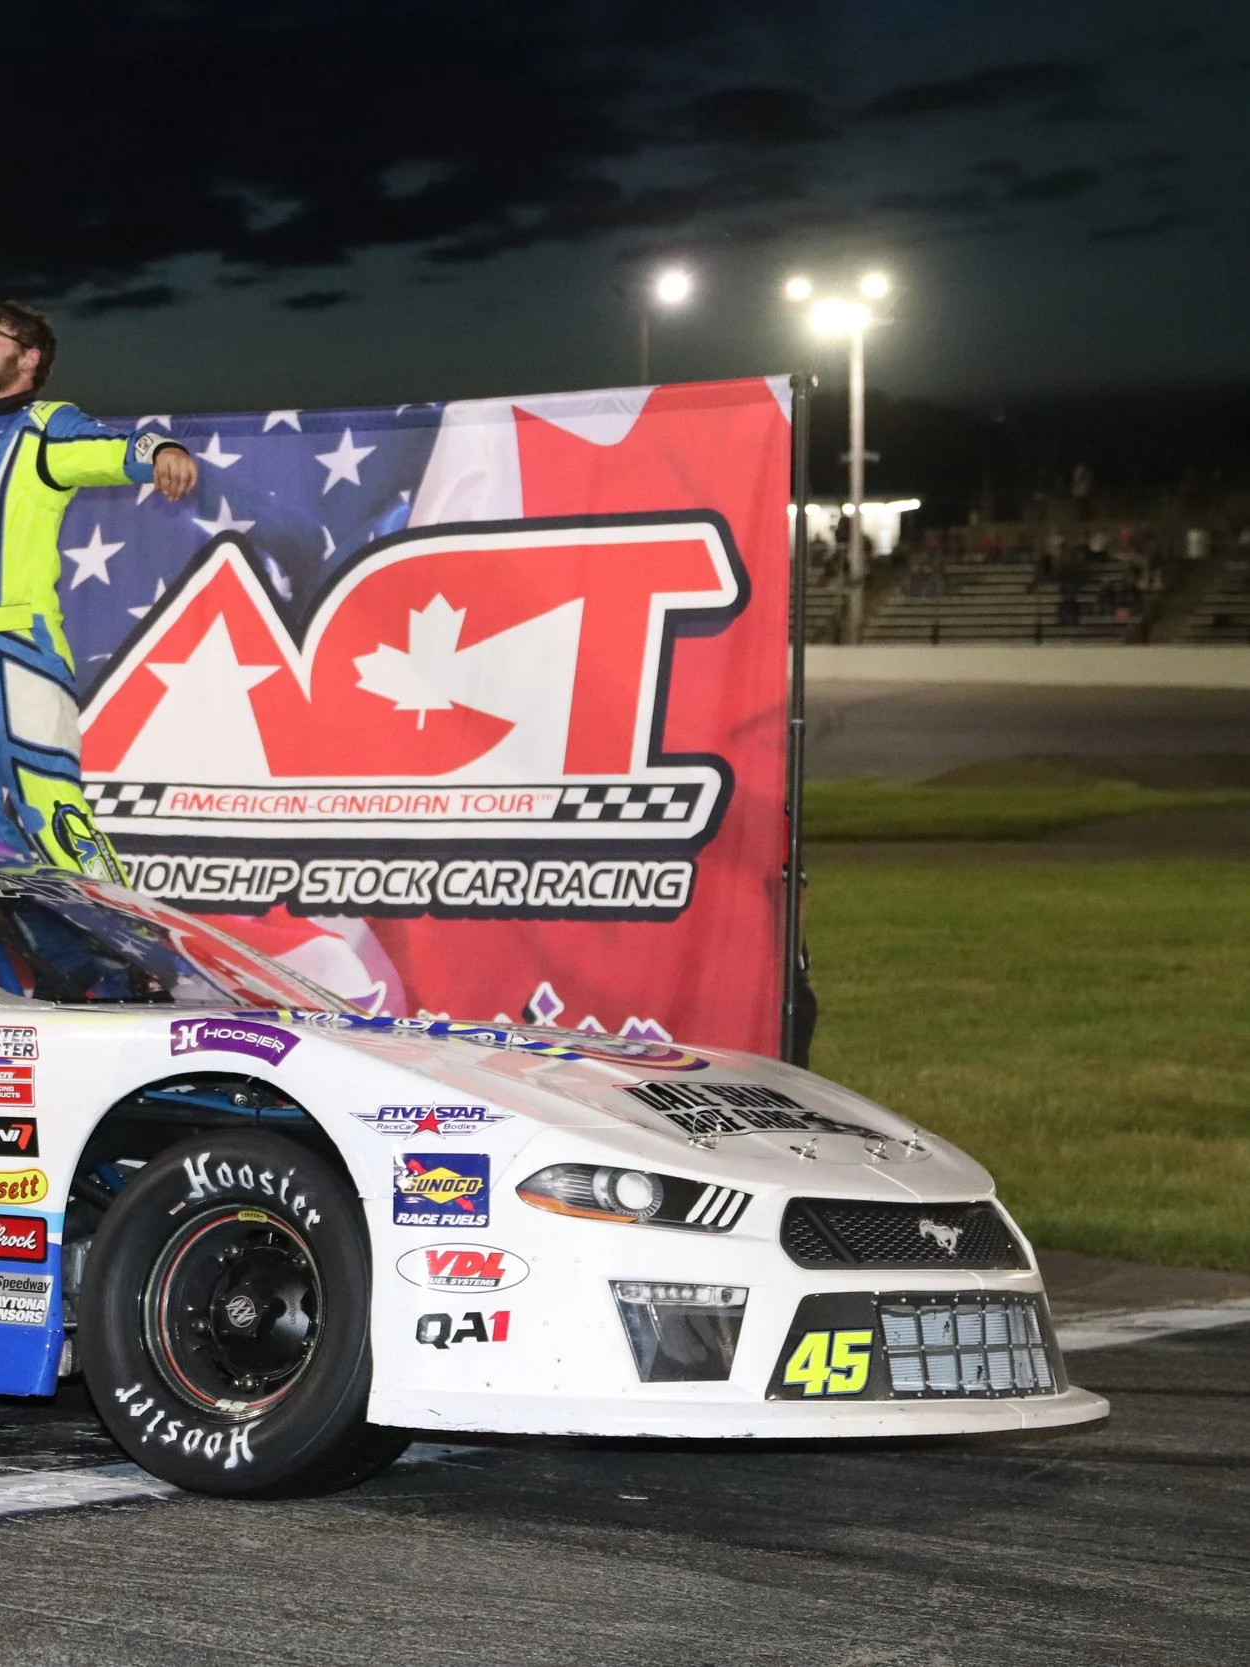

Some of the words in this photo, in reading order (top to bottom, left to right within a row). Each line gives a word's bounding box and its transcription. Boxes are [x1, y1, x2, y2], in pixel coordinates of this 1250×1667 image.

[79, 526, 732, 779] ACT
[169, 791, 450, 815] AMERICAN-CANADIAN
[460, 792, 535, 813] TOUR
[305, 862, 435, 899] STOCK
[442, 864, 523, 901] CAR
[534, 865, 686, 901] RACING
[204, 1028, 286, 1054] HOOSIER
[624, 1083, 722, 1112] DALE
[701, 1084, 805, 1110] SHAW
[376, 1122, 416, 1131] RaceCar
[443, 1123, 478, 1131] Bodies
[377, 1106, 428, 1121] FIVE
[435, 1106, 488, 1121] STAR
[732, 1109, 810, 1130] CARS
[182, 1150, 324, 1233] Hoosier
[405, 1177, 481, 1194] SUNOCO
[396, 1213, 440, 1225] RACE
[442, 1214, 488, 1227] FUELS
[425, 1250, 506, 1279] VDL
[449, 1278, 497, 1287] SYSTEMS
[415, 1310, 511, 1350] QA1
[783, 1329, 875, 1397] 45
[114, 1382, 264, 1470] Hoosier
